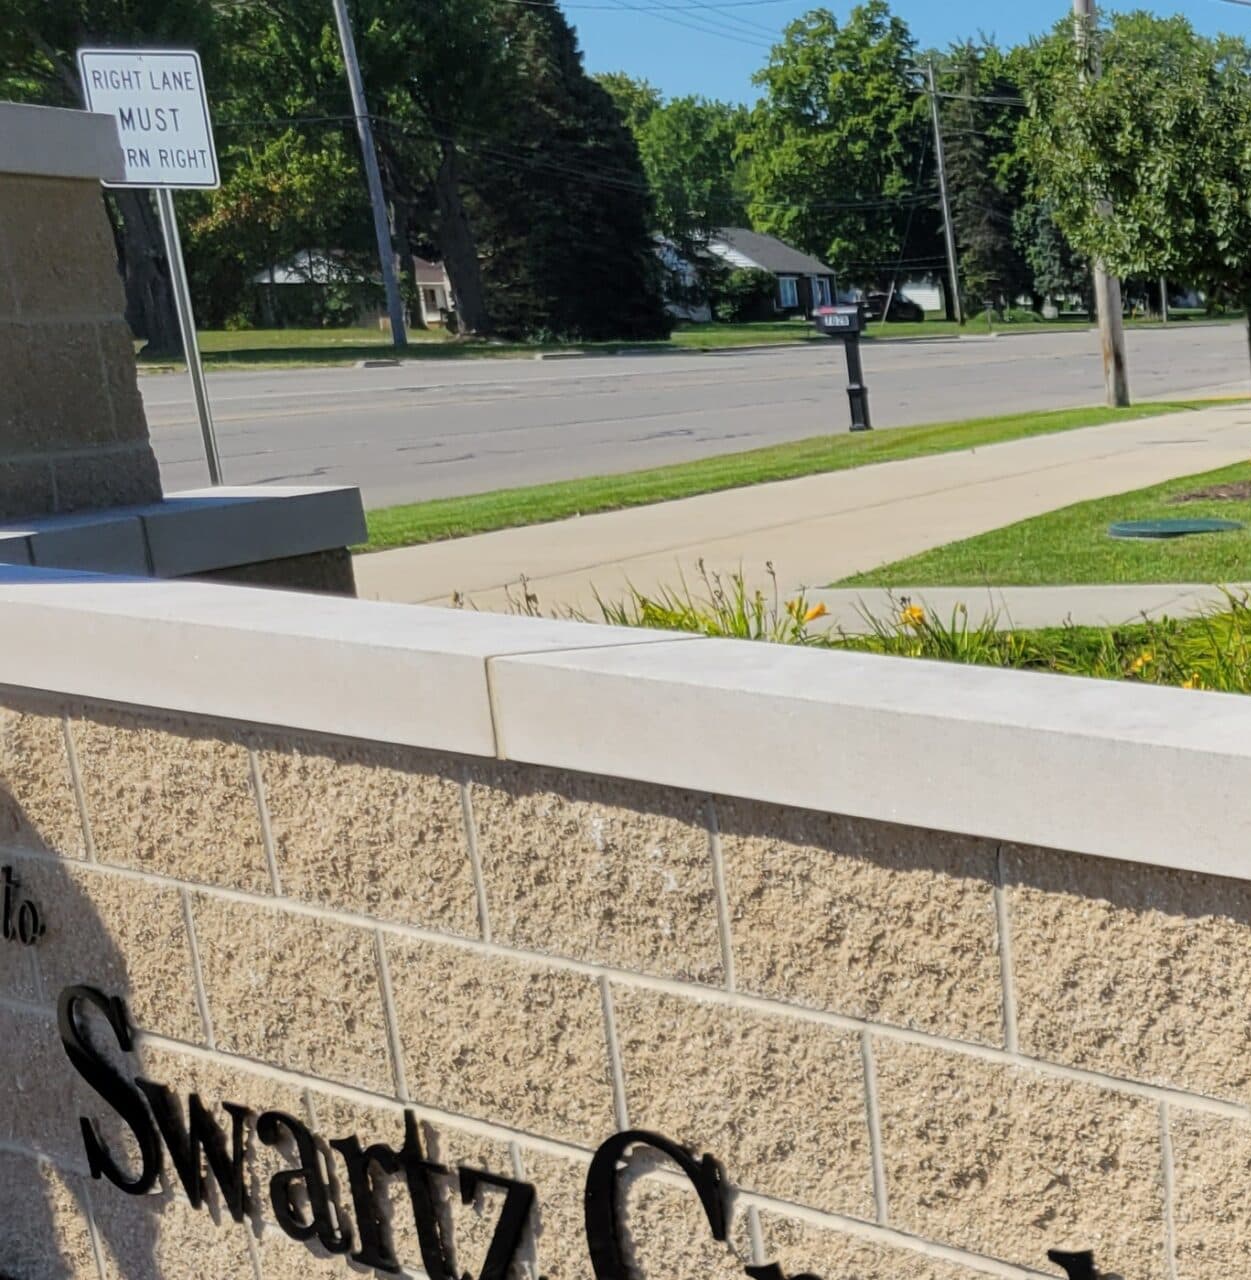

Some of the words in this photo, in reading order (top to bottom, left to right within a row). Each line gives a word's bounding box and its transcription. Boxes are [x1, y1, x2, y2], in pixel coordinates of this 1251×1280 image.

[92, 70, 142, 90] RIGHT
[150, 71, 195, 90] LANE
[119, 107, 180, 132] MUST
[124, 148, 150, 168] RN
[159, 149, 207, 168] RIGHT
